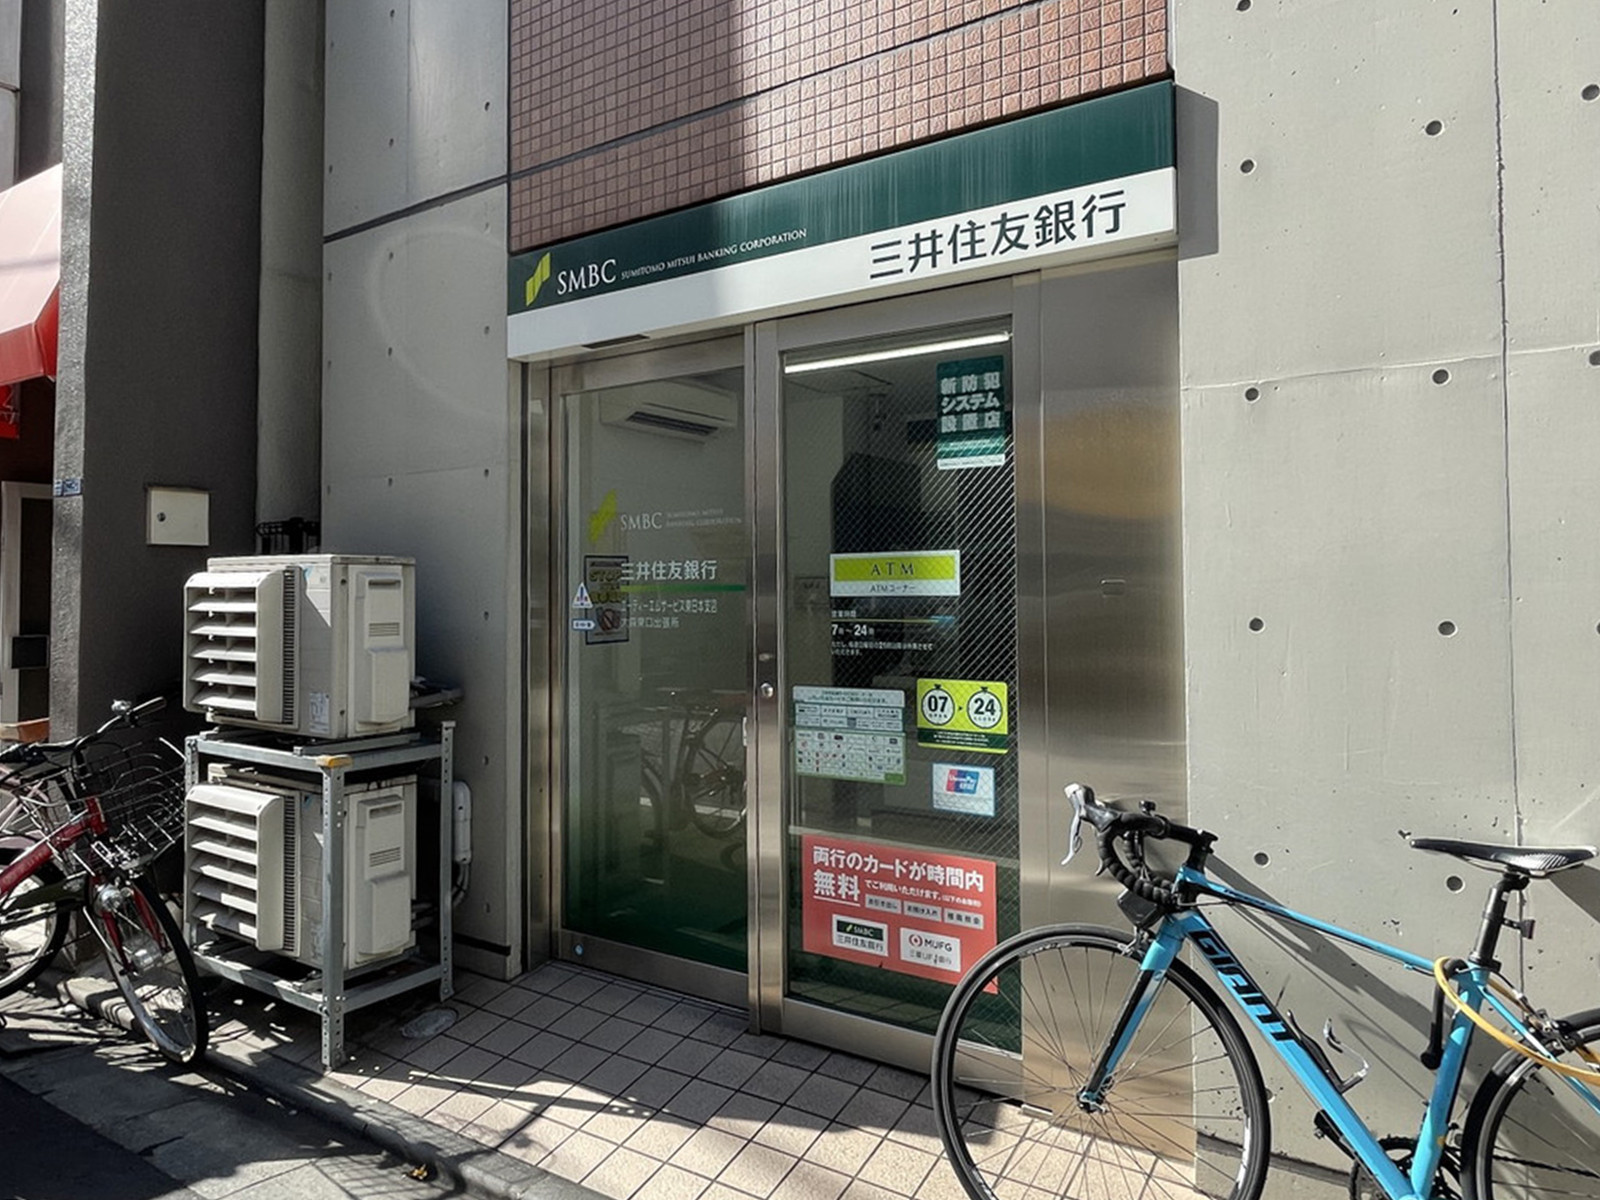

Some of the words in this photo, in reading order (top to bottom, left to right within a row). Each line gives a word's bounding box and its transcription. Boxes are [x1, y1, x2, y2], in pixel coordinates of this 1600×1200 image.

[869, 189, 1126, 280] 三井住友銀行
[620, 262, 666, 281] SUMITOMO
[666, 255, 697, 271] MITSUI
[697, 245, 738, 263] BANKING
[739, 228, 808, 253] CORPORATION
[556, 259, 617, 296] SMBC
[940, 391, 1000, 414] システム
[620, 511, 663, 531] SMBC
[620, 559, 718, 581] 三井住友銀行
[870, 562, 915, 577] ATM
[870, 584, 917, 593] ATMコーナー
[927, 695, 949, 713] 07
[973, 697, 996, 716] 24
[813, 845, 985, 893] 両行のカードが時間内
[813, 868, 861, 902] 無料
[924, 938, 953, 953] MUFG
[1187, 930, 1302, 1042] GIANT
